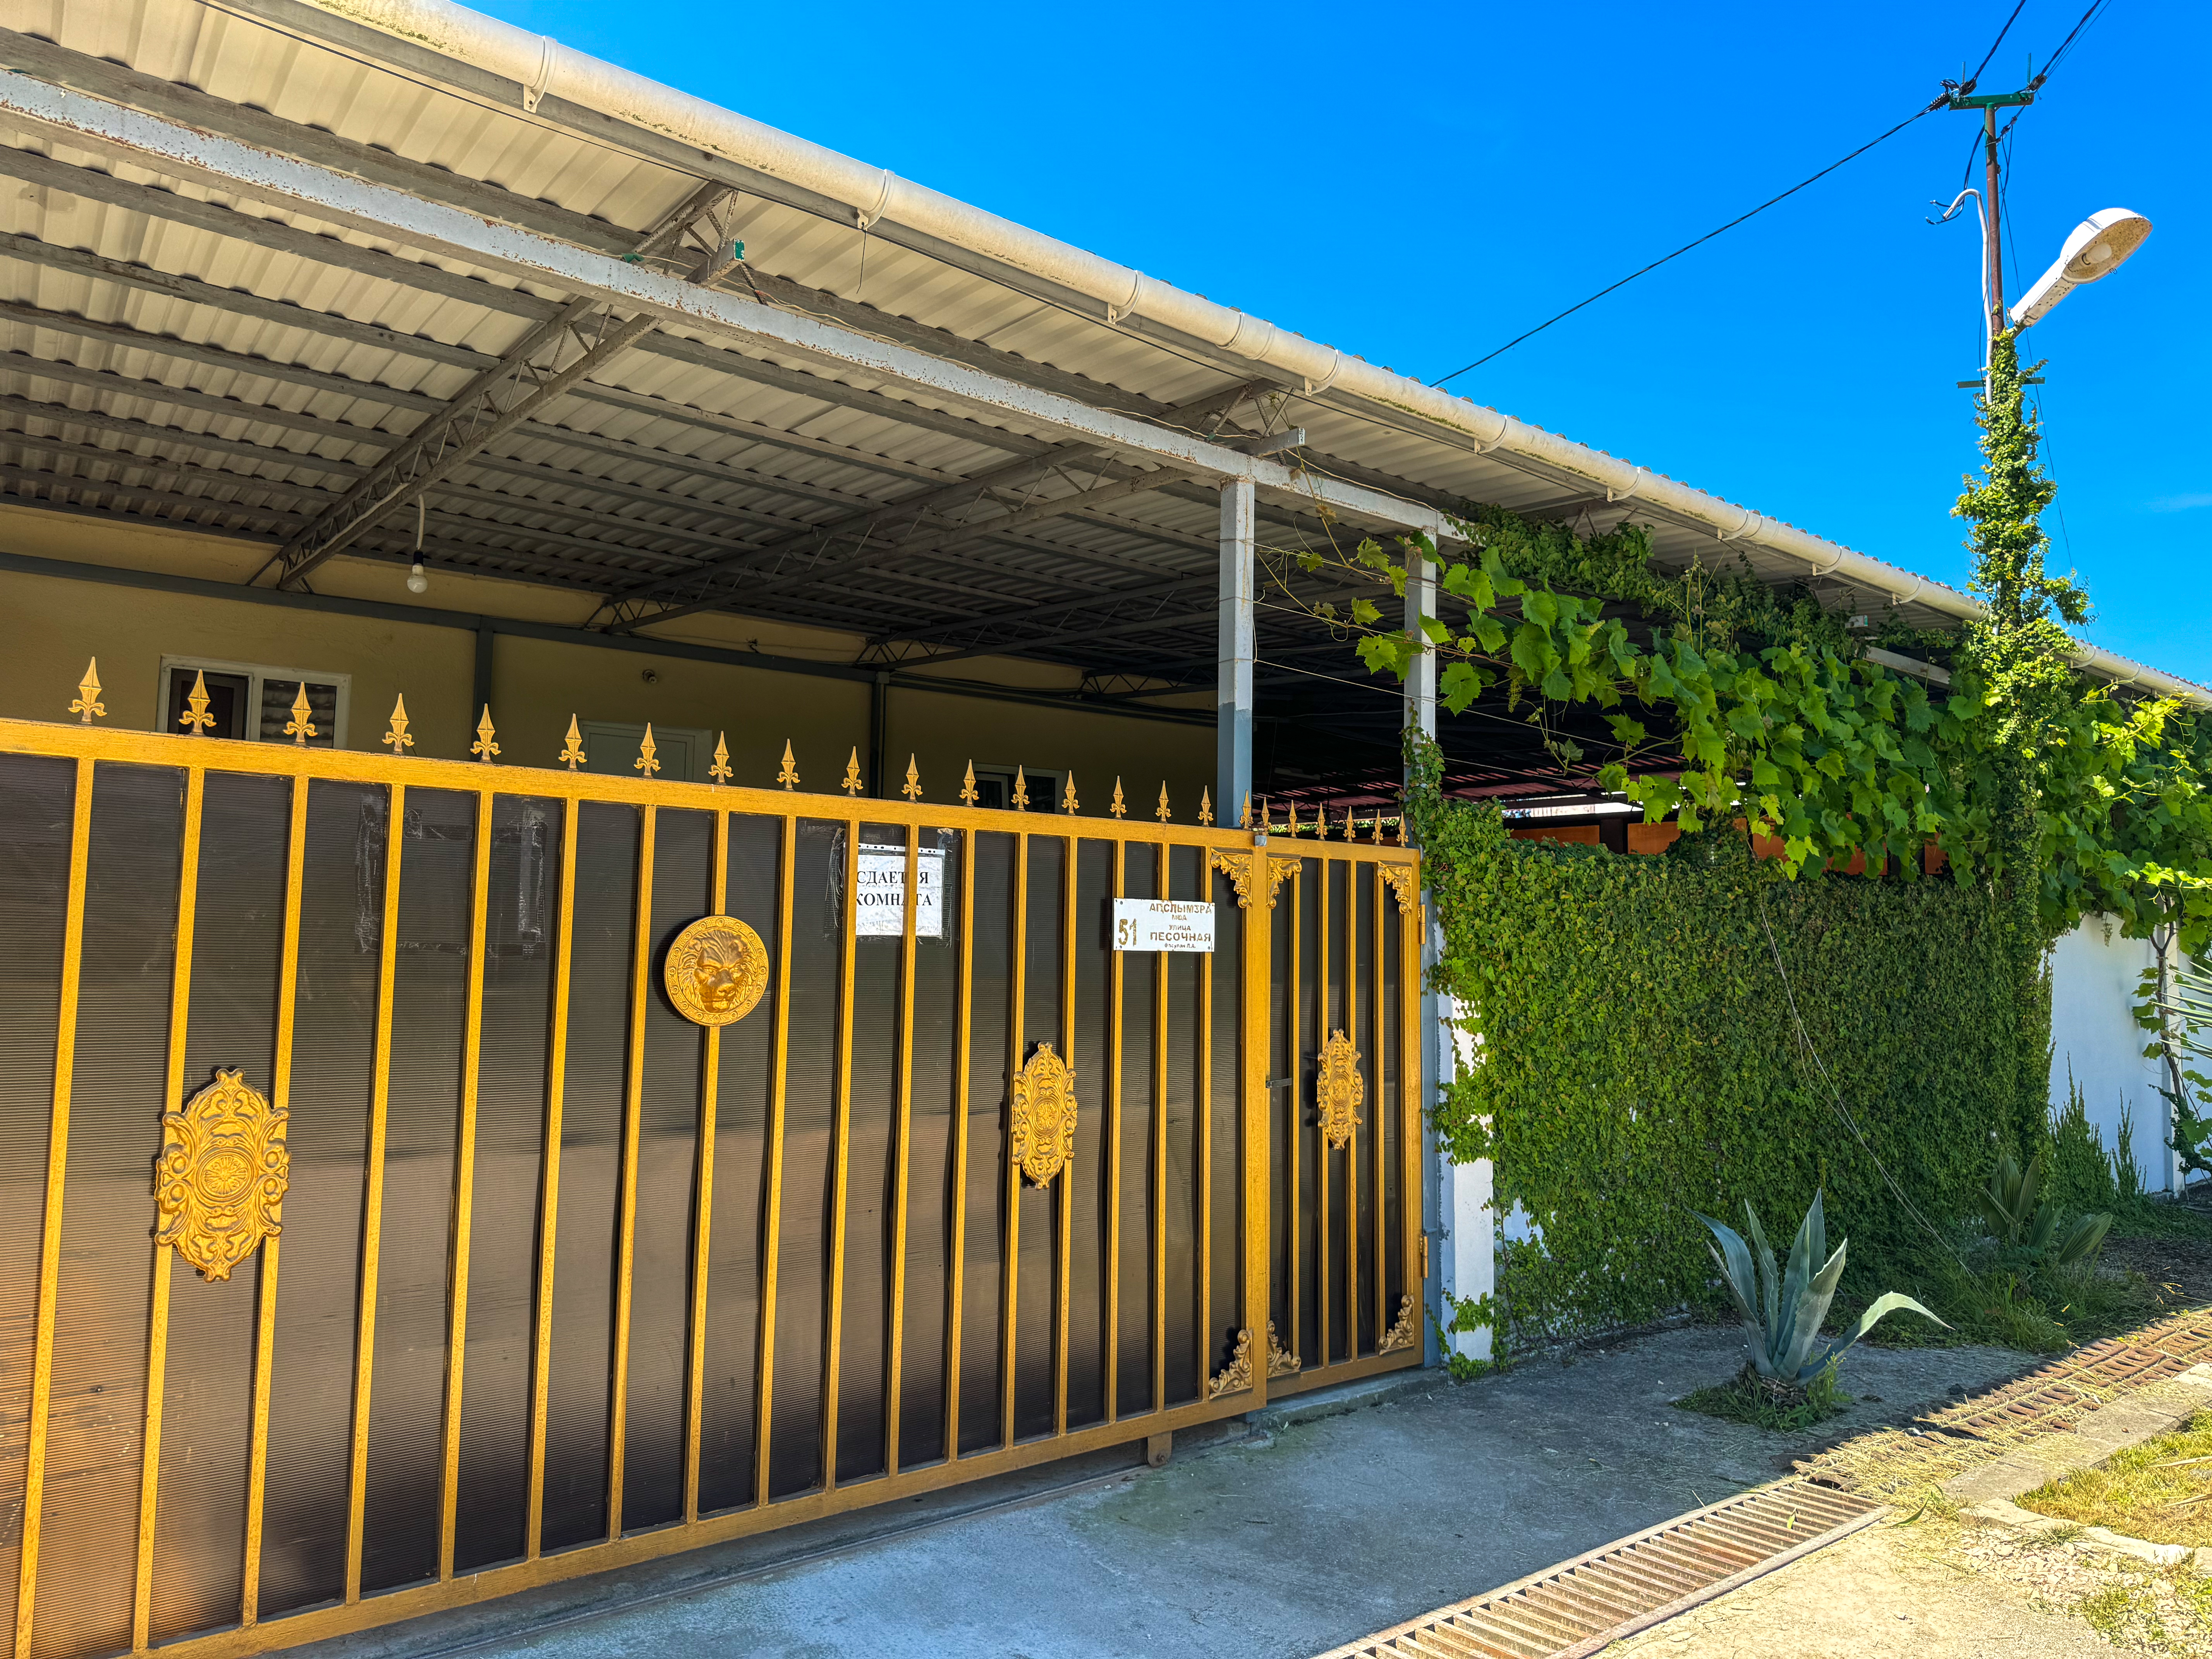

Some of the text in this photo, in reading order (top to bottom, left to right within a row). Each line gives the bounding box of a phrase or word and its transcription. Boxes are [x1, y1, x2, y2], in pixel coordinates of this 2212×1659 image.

[857, 871, 929, 886] СДАЕТЯ
[857, 893, 932, 906] КОМНТА
[1118, 918, 1137, 946] 51
[1150, 932, 1211, 941] ПЕСОЧНАЯ
